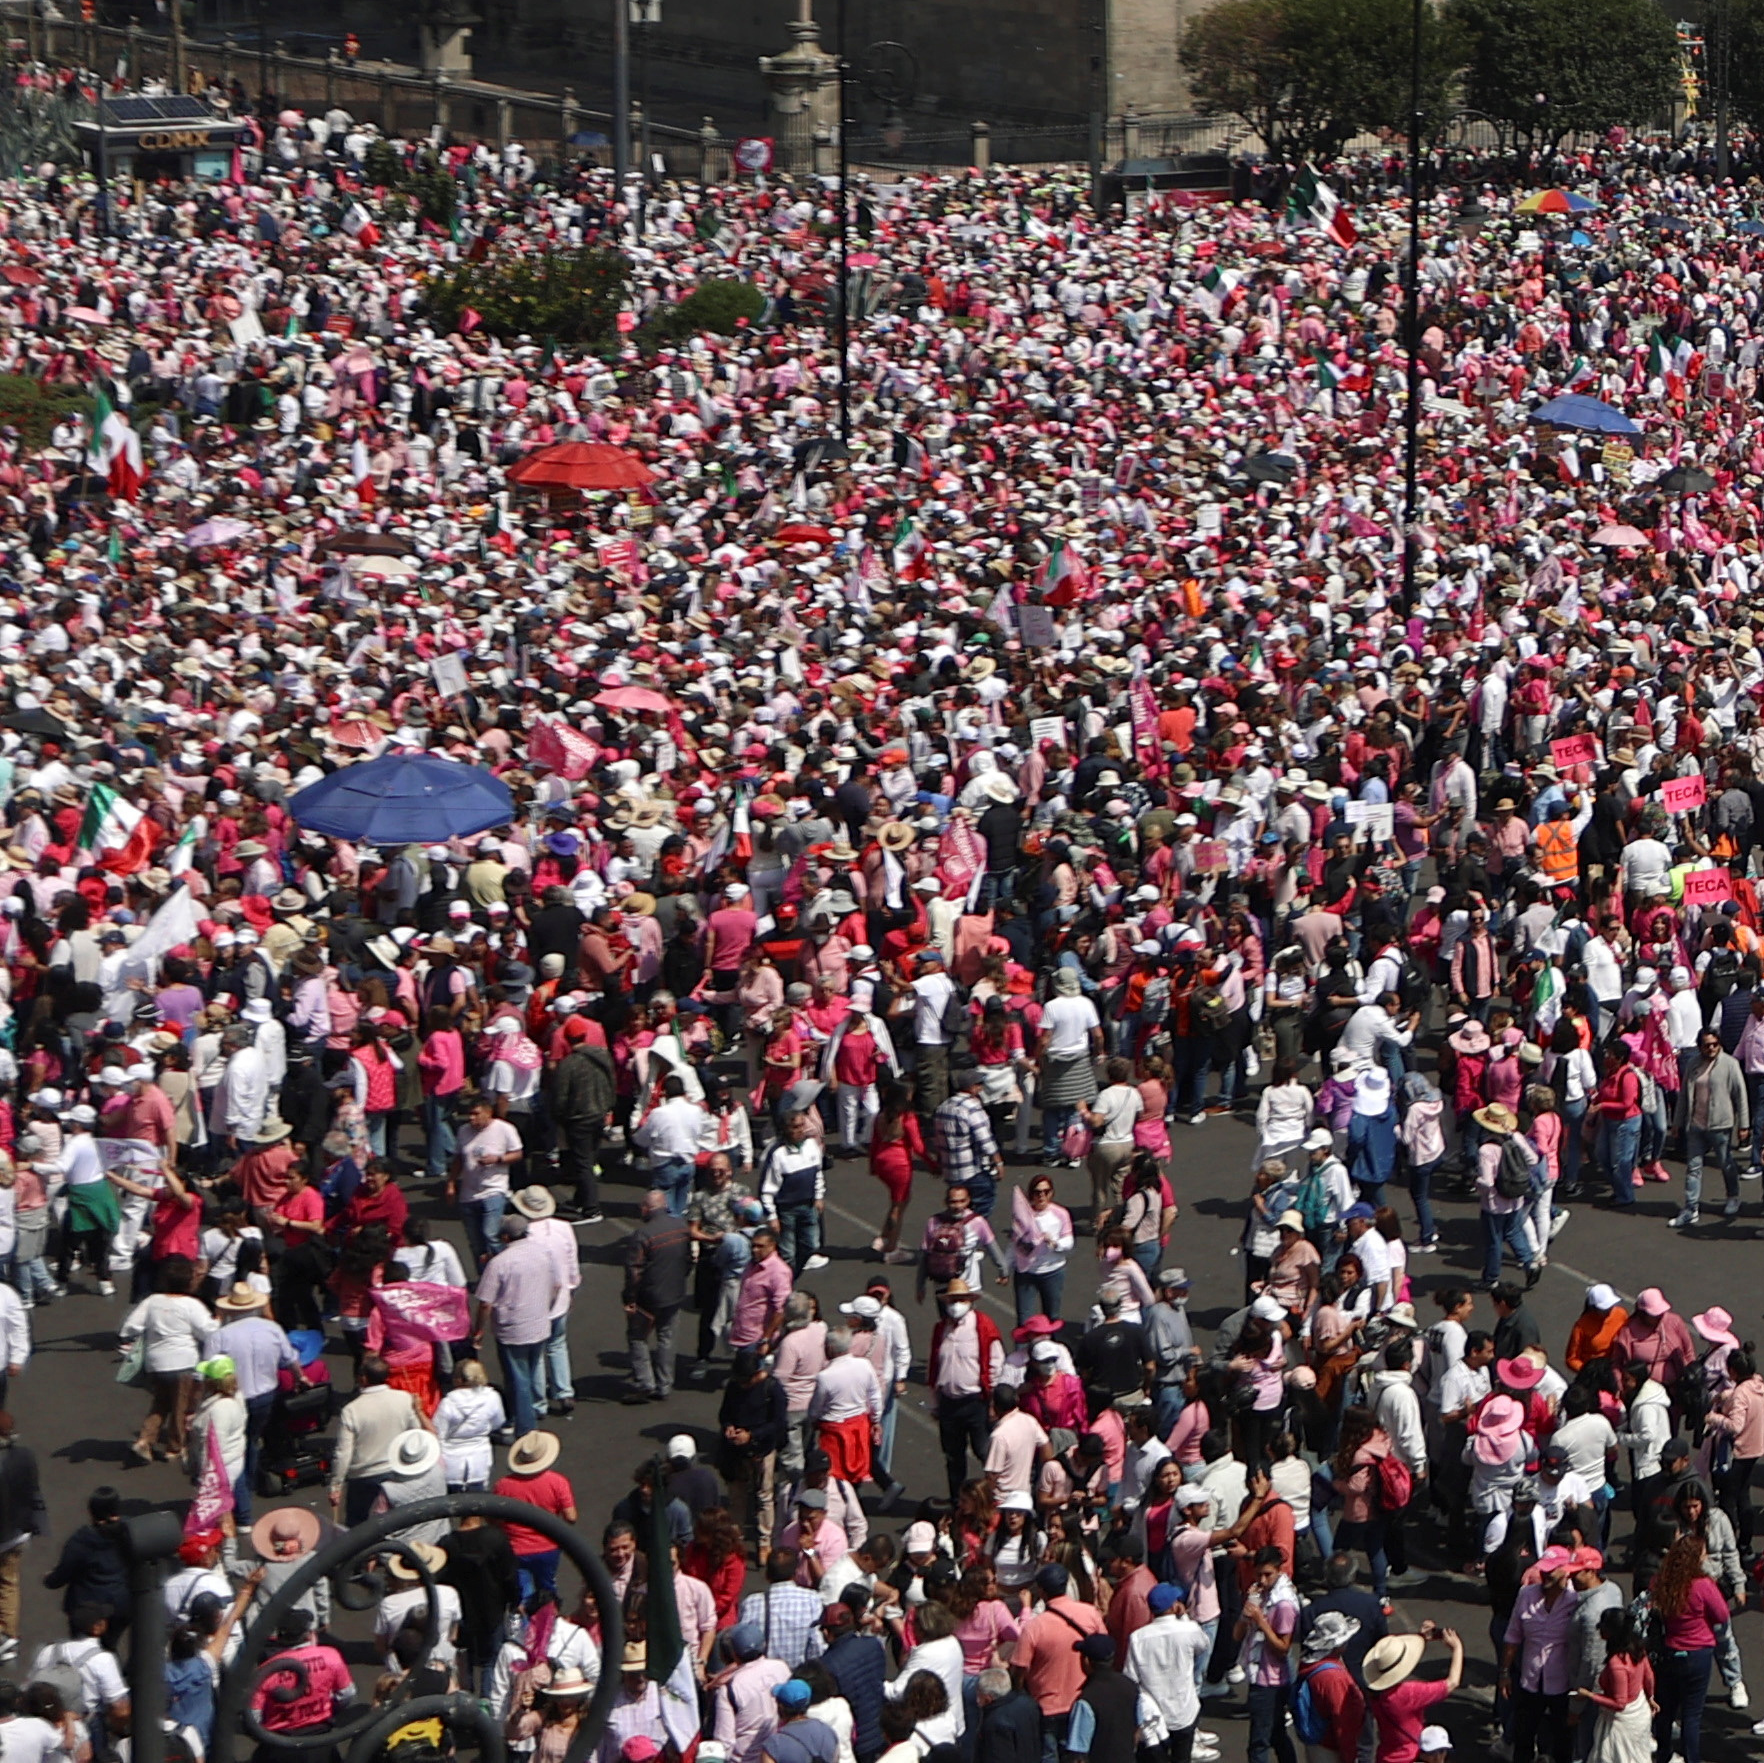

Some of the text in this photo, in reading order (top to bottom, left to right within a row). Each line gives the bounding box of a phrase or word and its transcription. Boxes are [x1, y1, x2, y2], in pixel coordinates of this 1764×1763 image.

[139, 131, 210, 149] CDMX
[1556, 743, 1594, 760] TECA
[1665, 785, 1703, 803] TECA
[1685, 878, 1728, 894] TECA
